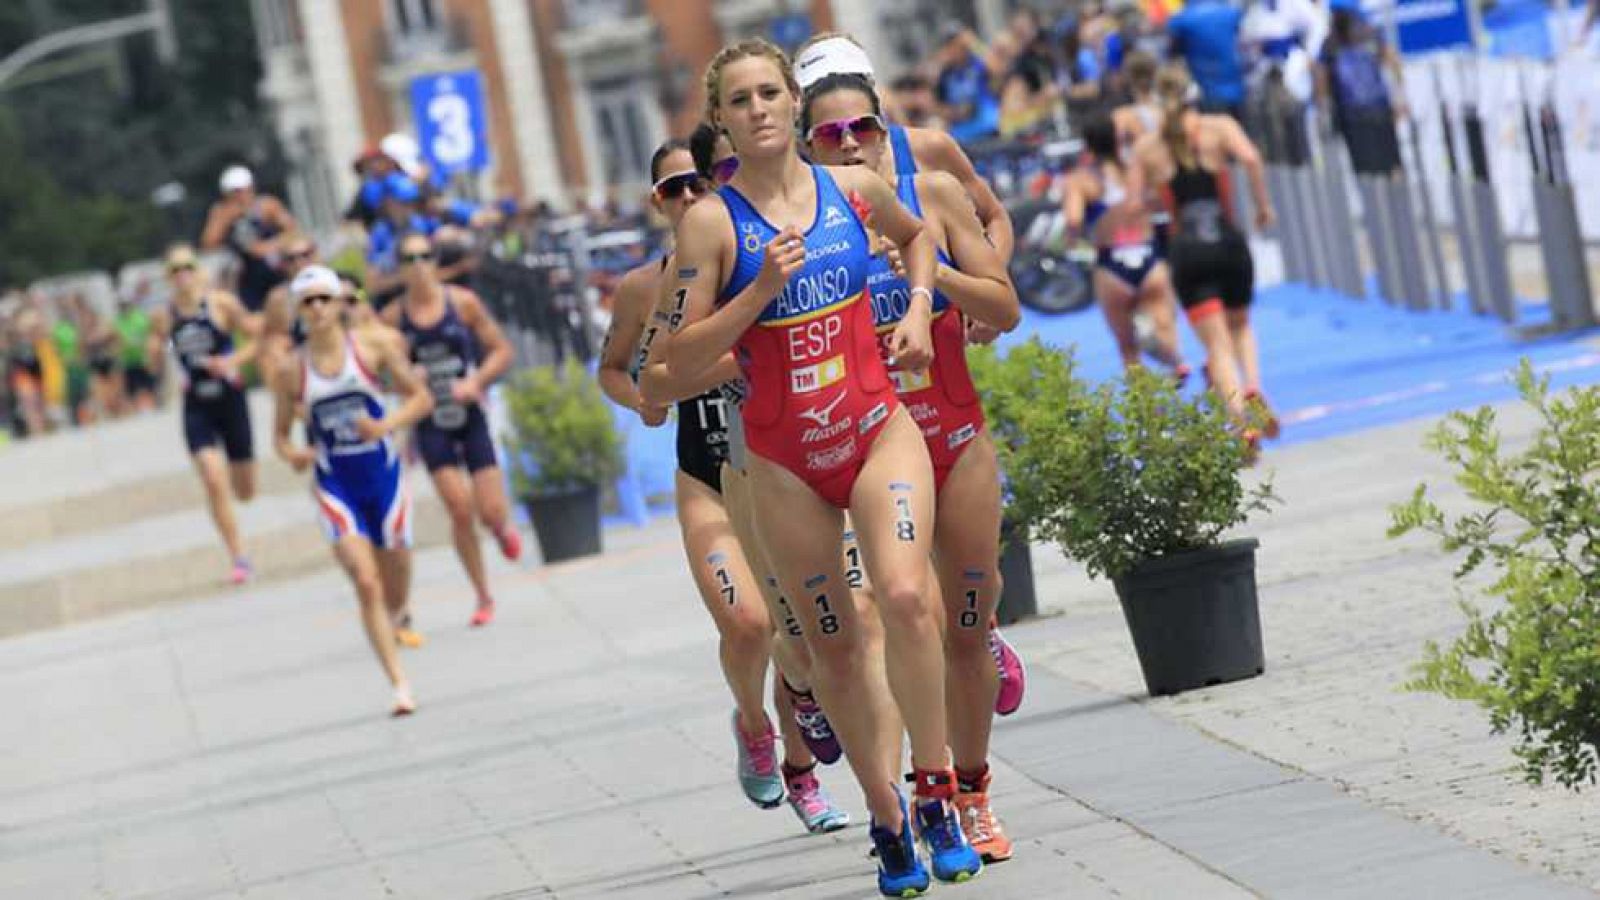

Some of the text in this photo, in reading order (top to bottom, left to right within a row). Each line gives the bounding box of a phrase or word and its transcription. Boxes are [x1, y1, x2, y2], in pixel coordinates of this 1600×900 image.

[428, 95, 475, 162] 3
[776, 265, 849, 315] ALONSO
[789, 315, 842, 362] ESP
[696, 398, 729, 429] IT
